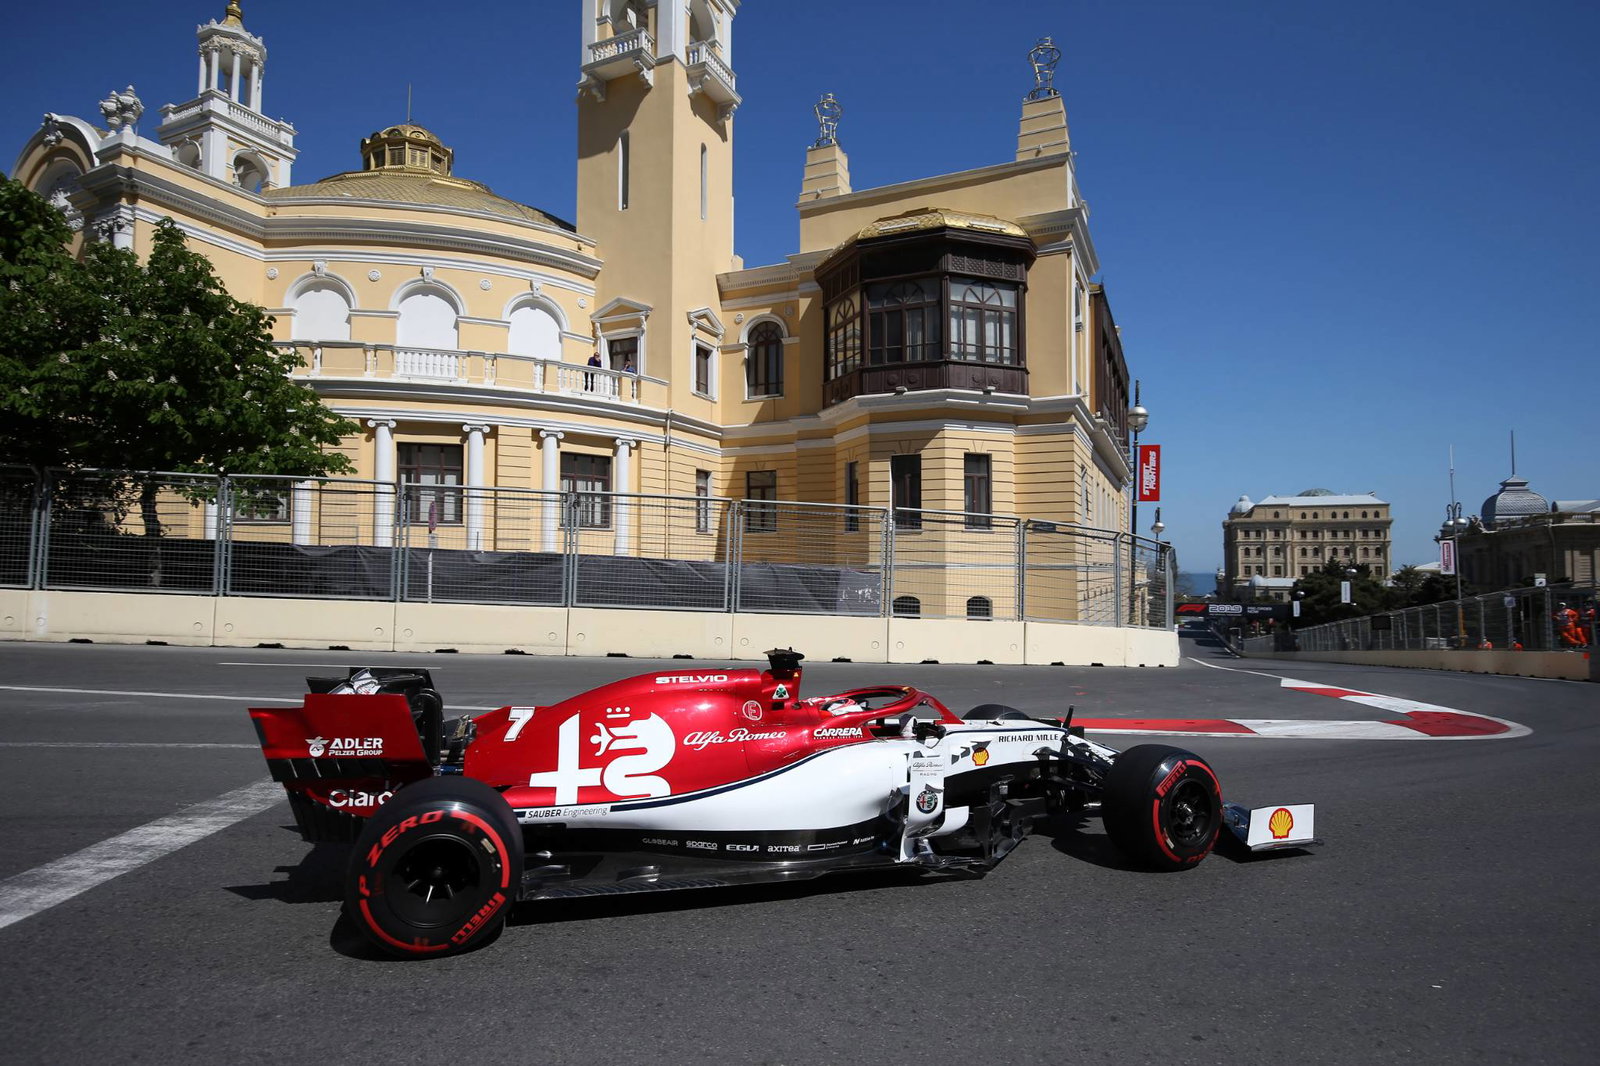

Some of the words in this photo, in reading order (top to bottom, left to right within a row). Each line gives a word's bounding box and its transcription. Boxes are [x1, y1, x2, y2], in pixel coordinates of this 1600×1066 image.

[1208, 604, 1243, 614] 2019
[655, 674, 728, 684] STELVIO
[503, 706, 536, 742] 7
[813, 727, 863, 737] CARRERA
[329, 737, 383, 749] ADLER
[683, 731, 728, 751] Alfa
[728, 728, 787, 743] Romeo
[998, 734, 1034, 743] RICHARD
[1036, 733, 1059, 741] MILLE
[528, 809, 562, 818] SAUBER
[562, 807, 608, 818] Engineering
[366, 809, 446, 868] ZERO
[686, 840, 718, 850] sparco
[451, 892, 507, 945] PIRELLI
